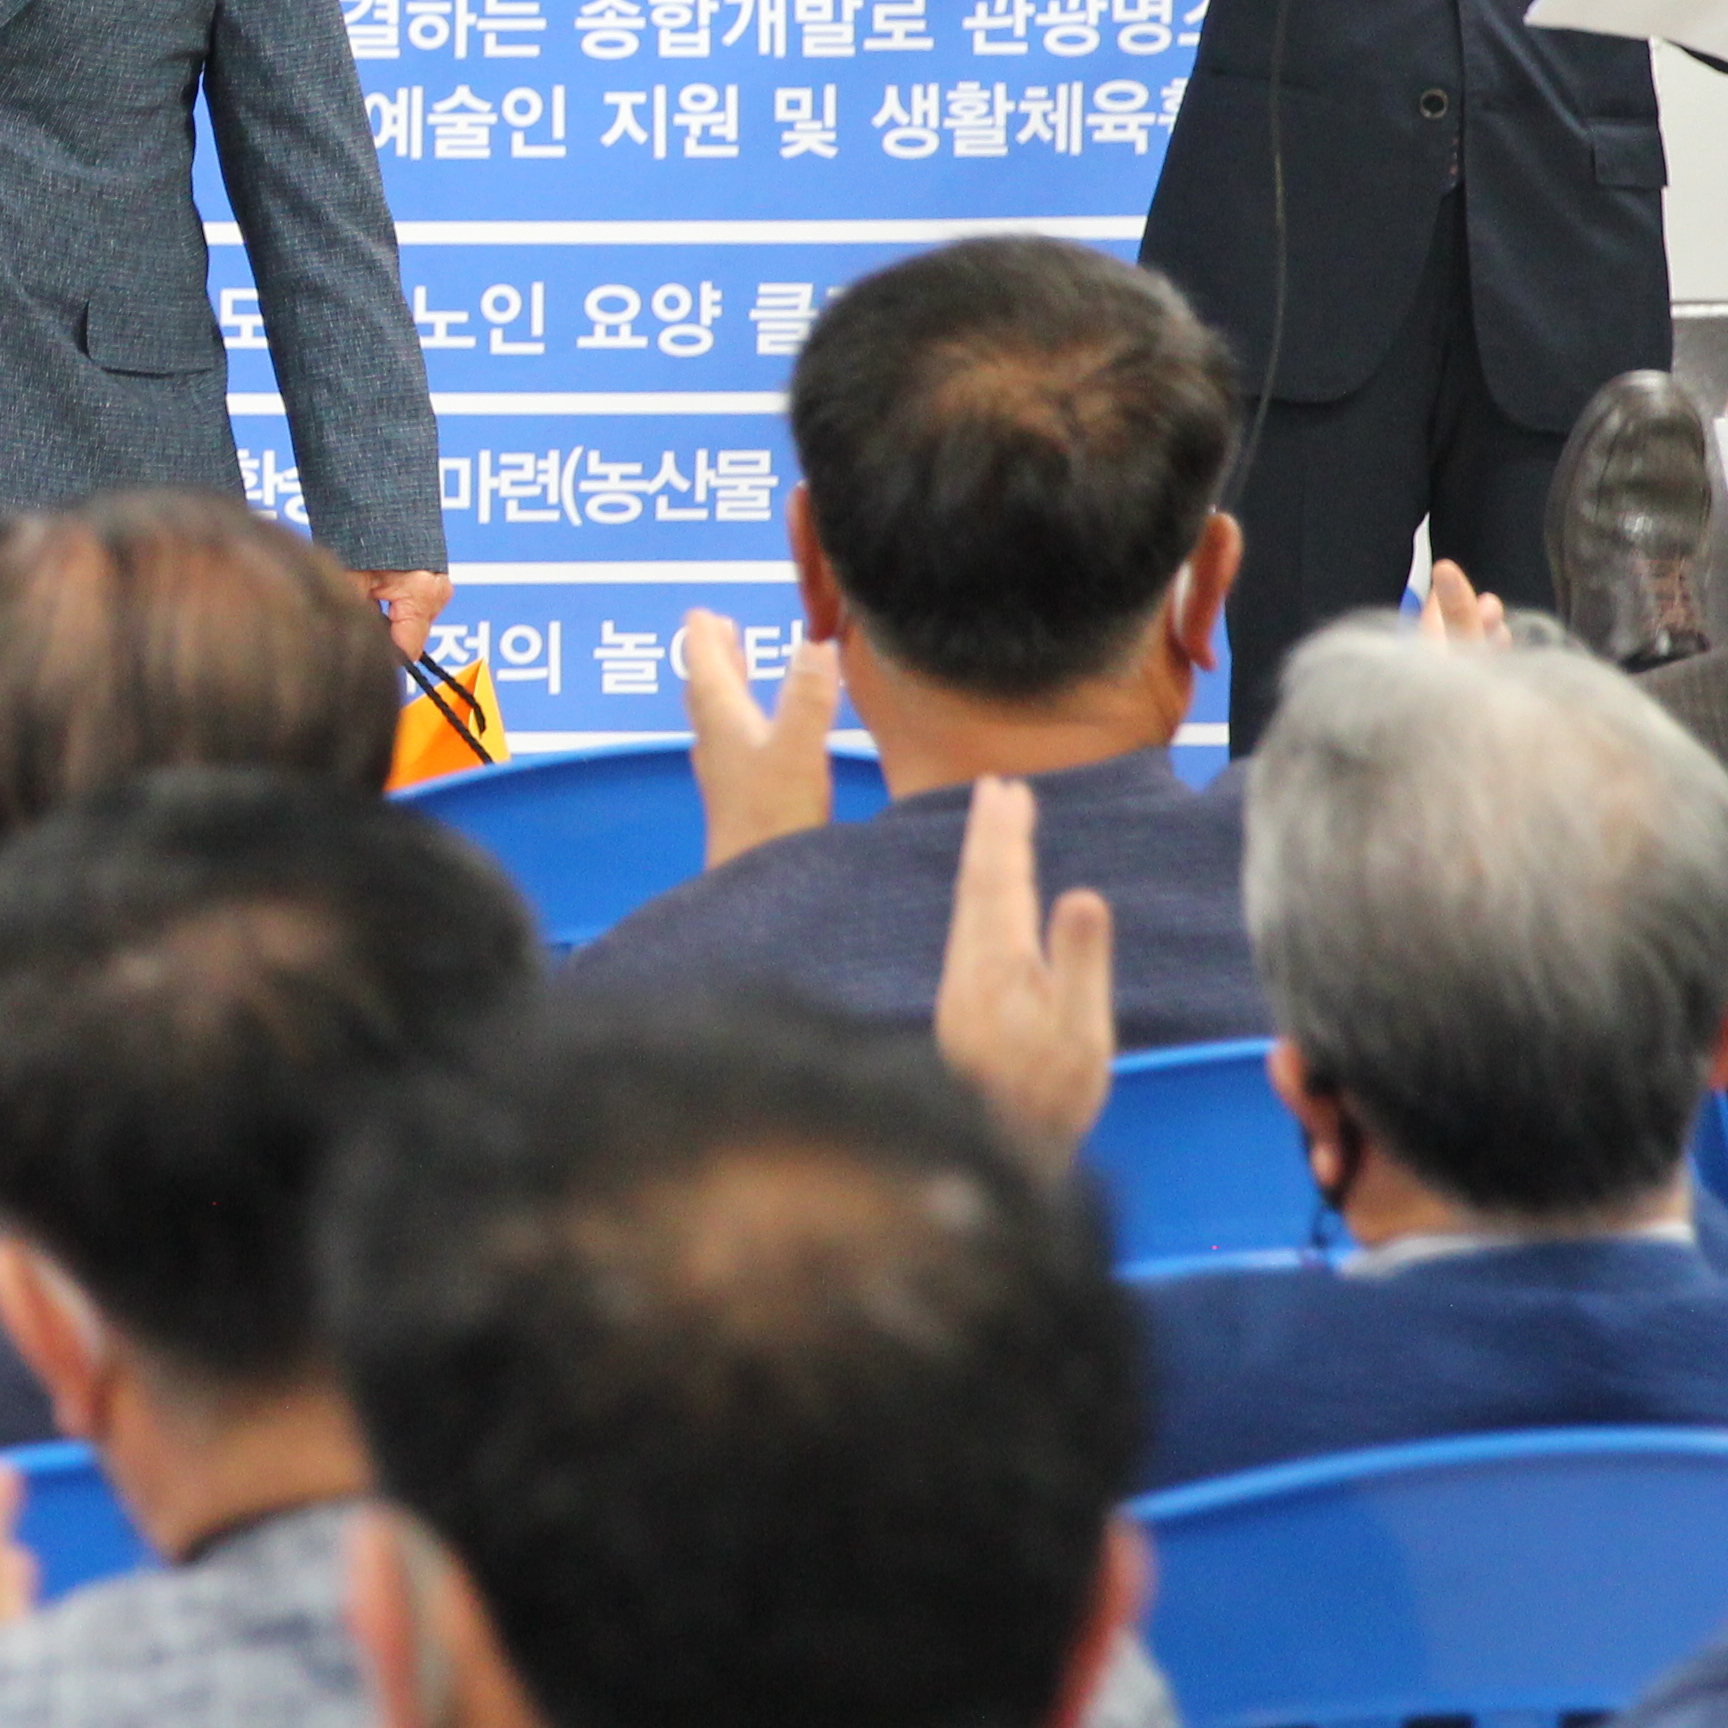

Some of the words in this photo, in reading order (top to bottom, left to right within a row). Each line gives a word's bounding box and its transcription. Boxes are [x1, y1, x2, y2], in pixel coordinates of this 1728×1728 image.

[364, 83, 568, 160] 예술인
[600, 83, 740, 160] 지원
[774, 83, 839, 159] 및
[413, 280, 545, 356] 노인
[576, 280, 724, 357] 요양
[593, 619, 804, 695] 놀터
